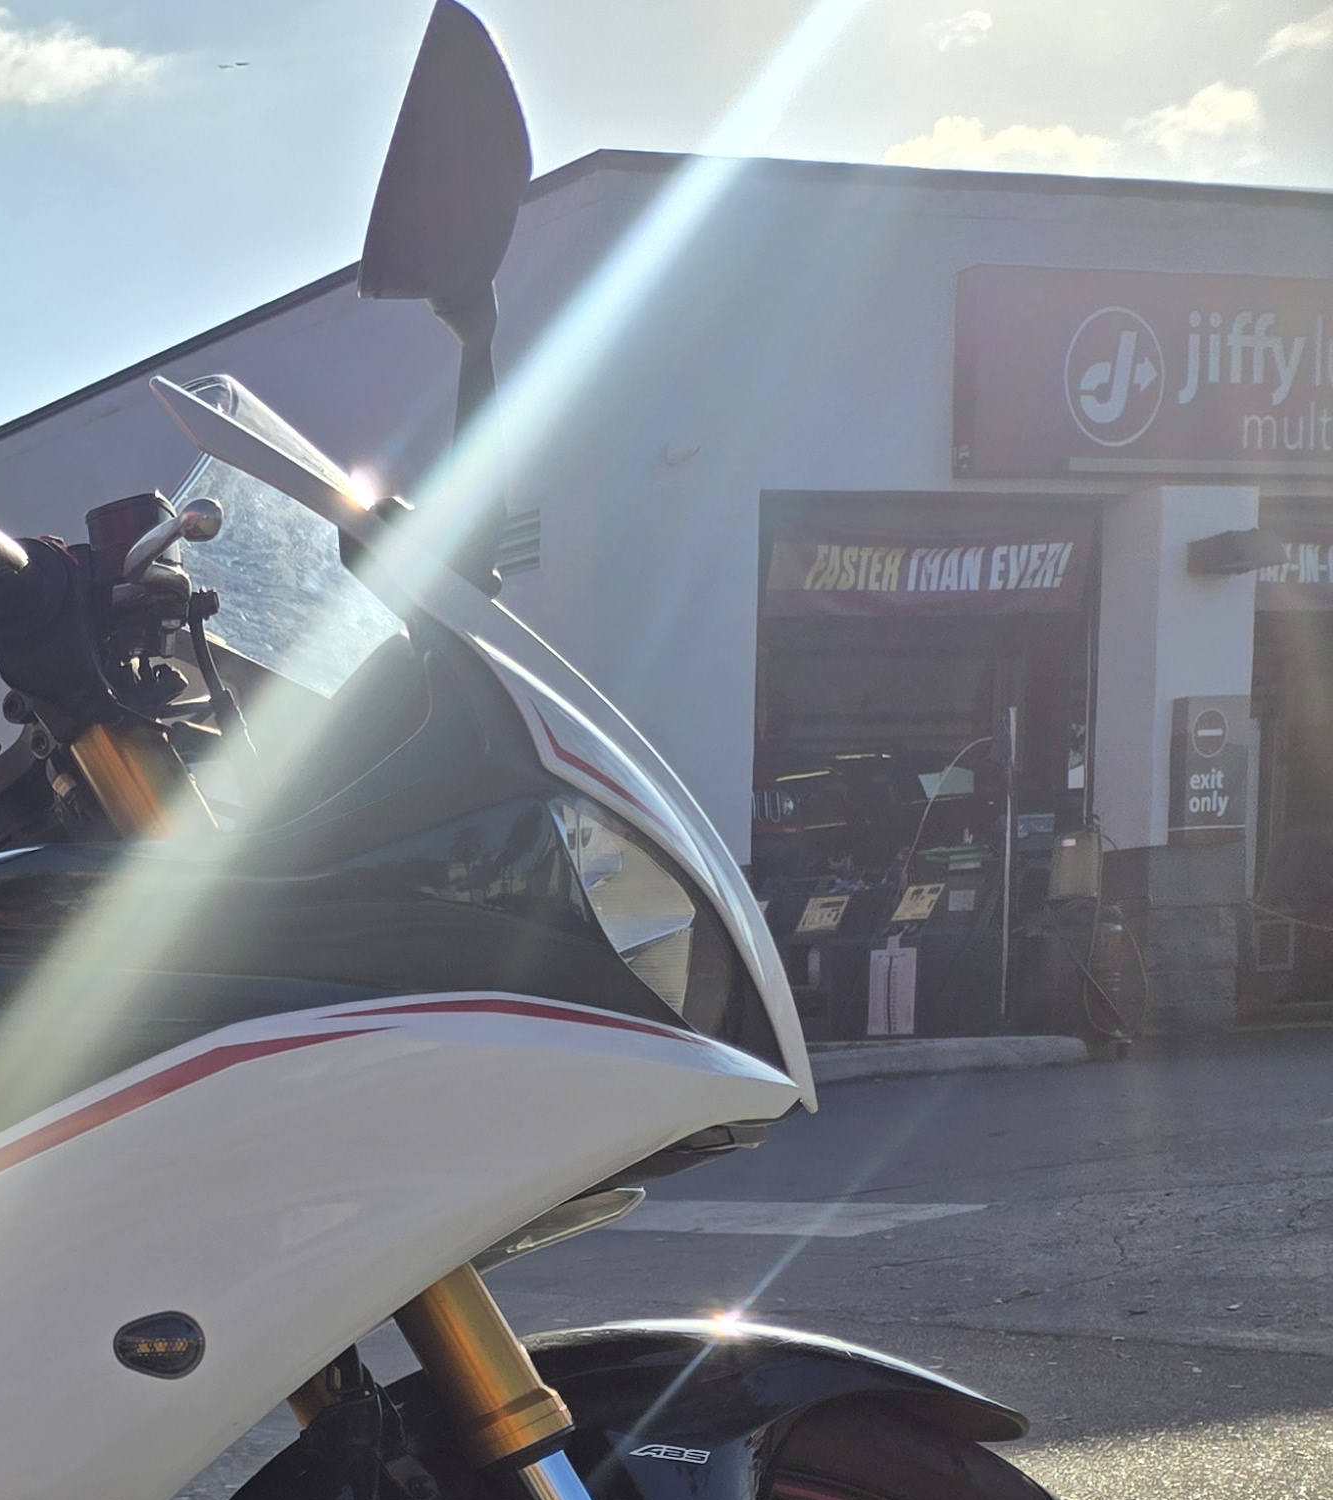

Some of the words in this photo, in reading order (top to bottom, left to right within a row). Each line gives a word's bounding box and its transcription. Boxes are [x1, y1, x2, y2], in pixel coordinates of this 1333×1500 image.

[1178, 310, 1308, 406] jiffy
[803, 544, 908, 592] FASTER
[906, 546, 986, 592] THAN
[988, 541, 1074, 591] EVER!
[1189, 768, 1225, 790] exit
[1188, 790, 1229, 817] only
[629, 1443, 711, 1465] ABS
